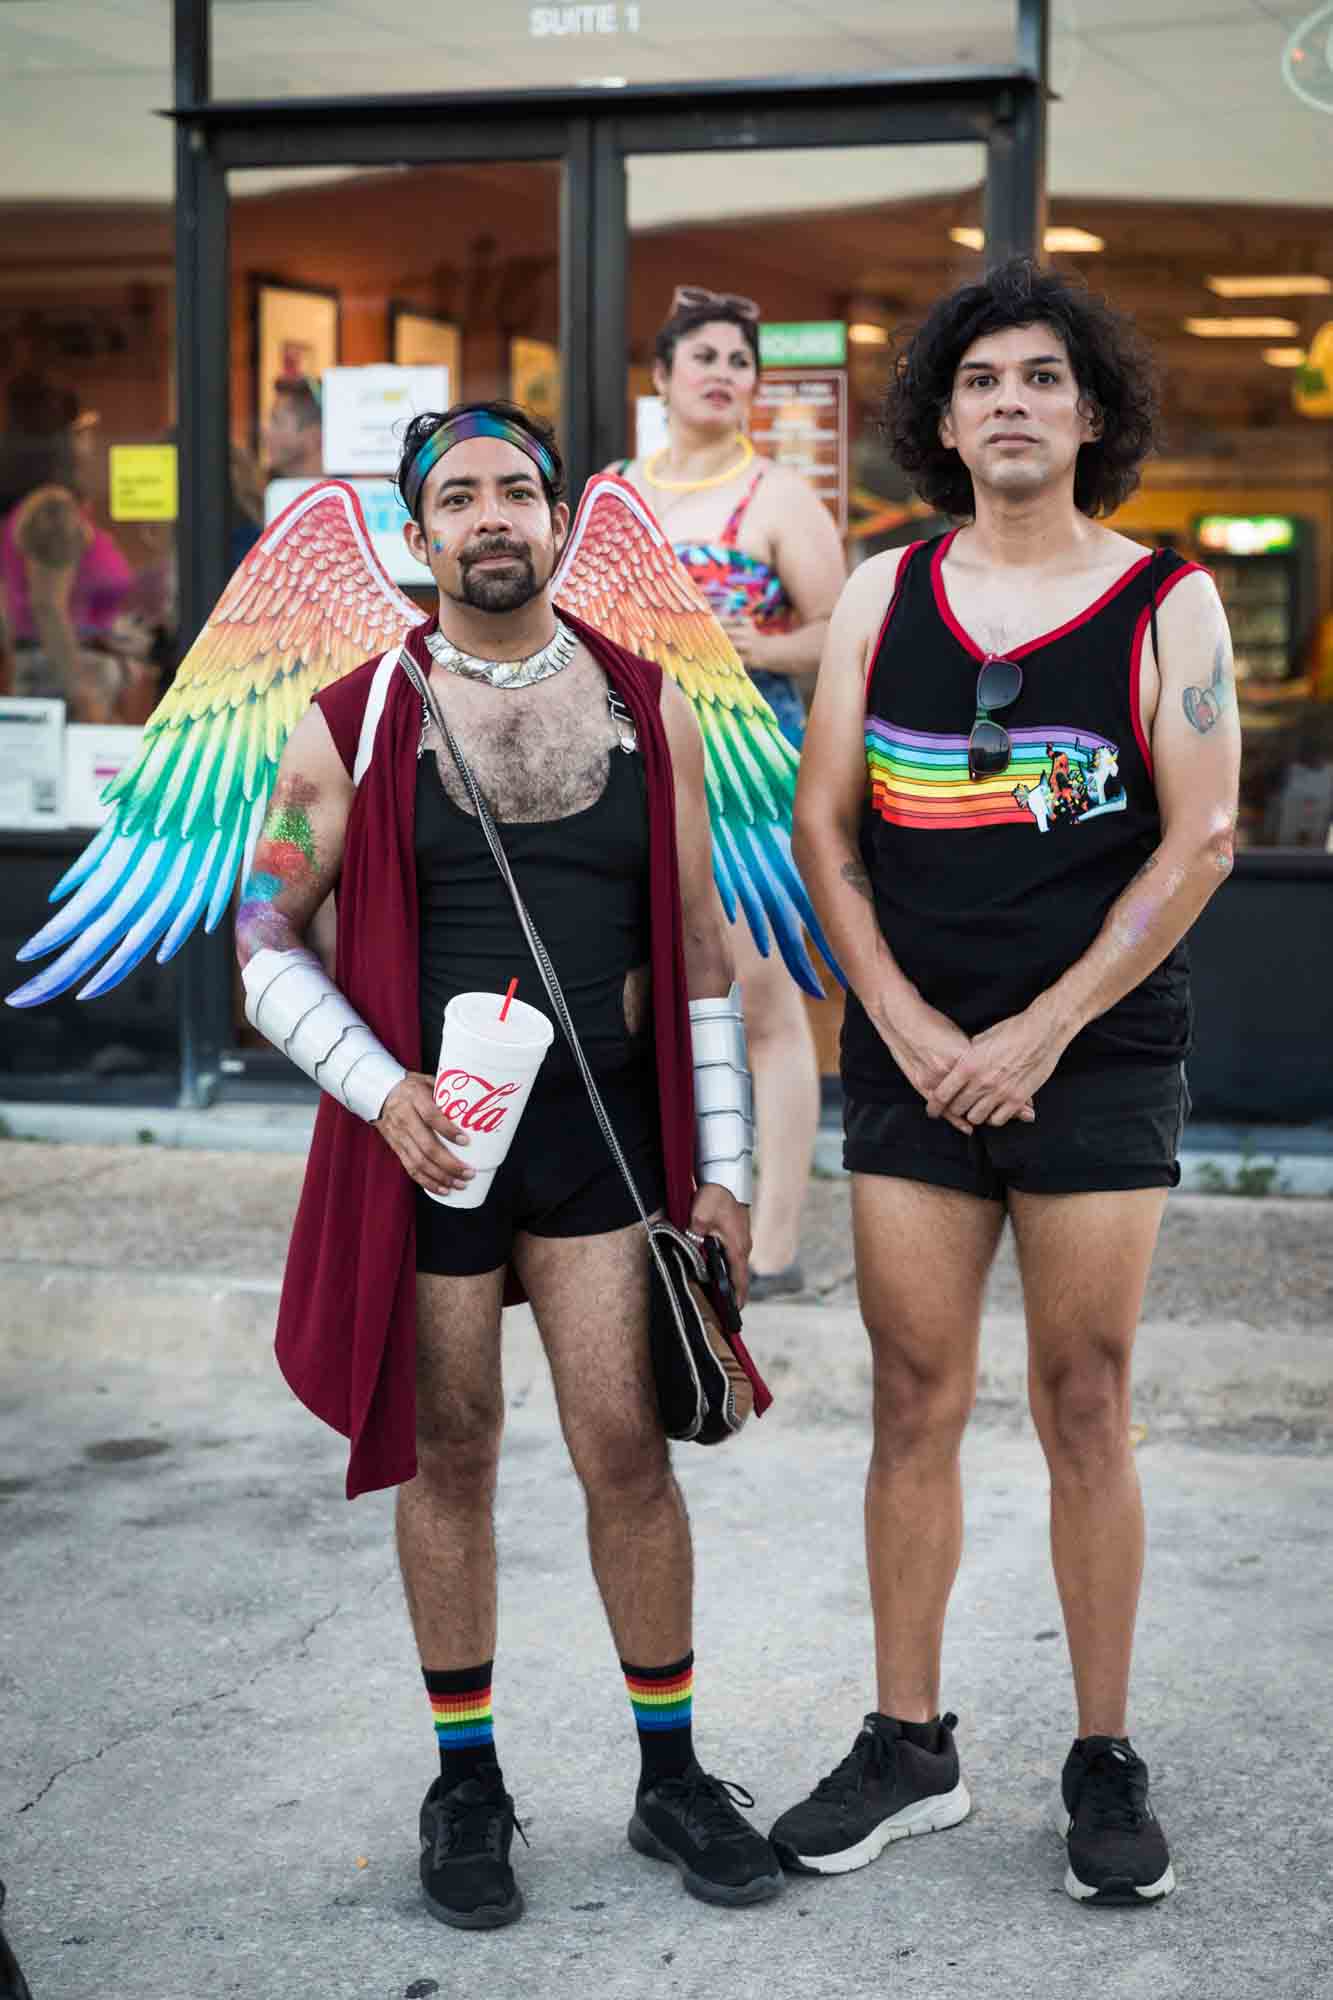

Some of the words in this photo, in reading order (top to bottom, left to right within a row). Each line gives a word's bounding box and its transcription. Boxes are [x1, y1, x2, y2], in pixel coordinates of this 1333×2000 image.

[529, 6, 617, 35] SUITE
[627, 4, 640, 32] 1
[433, 1068, 521, 1133] Cola
